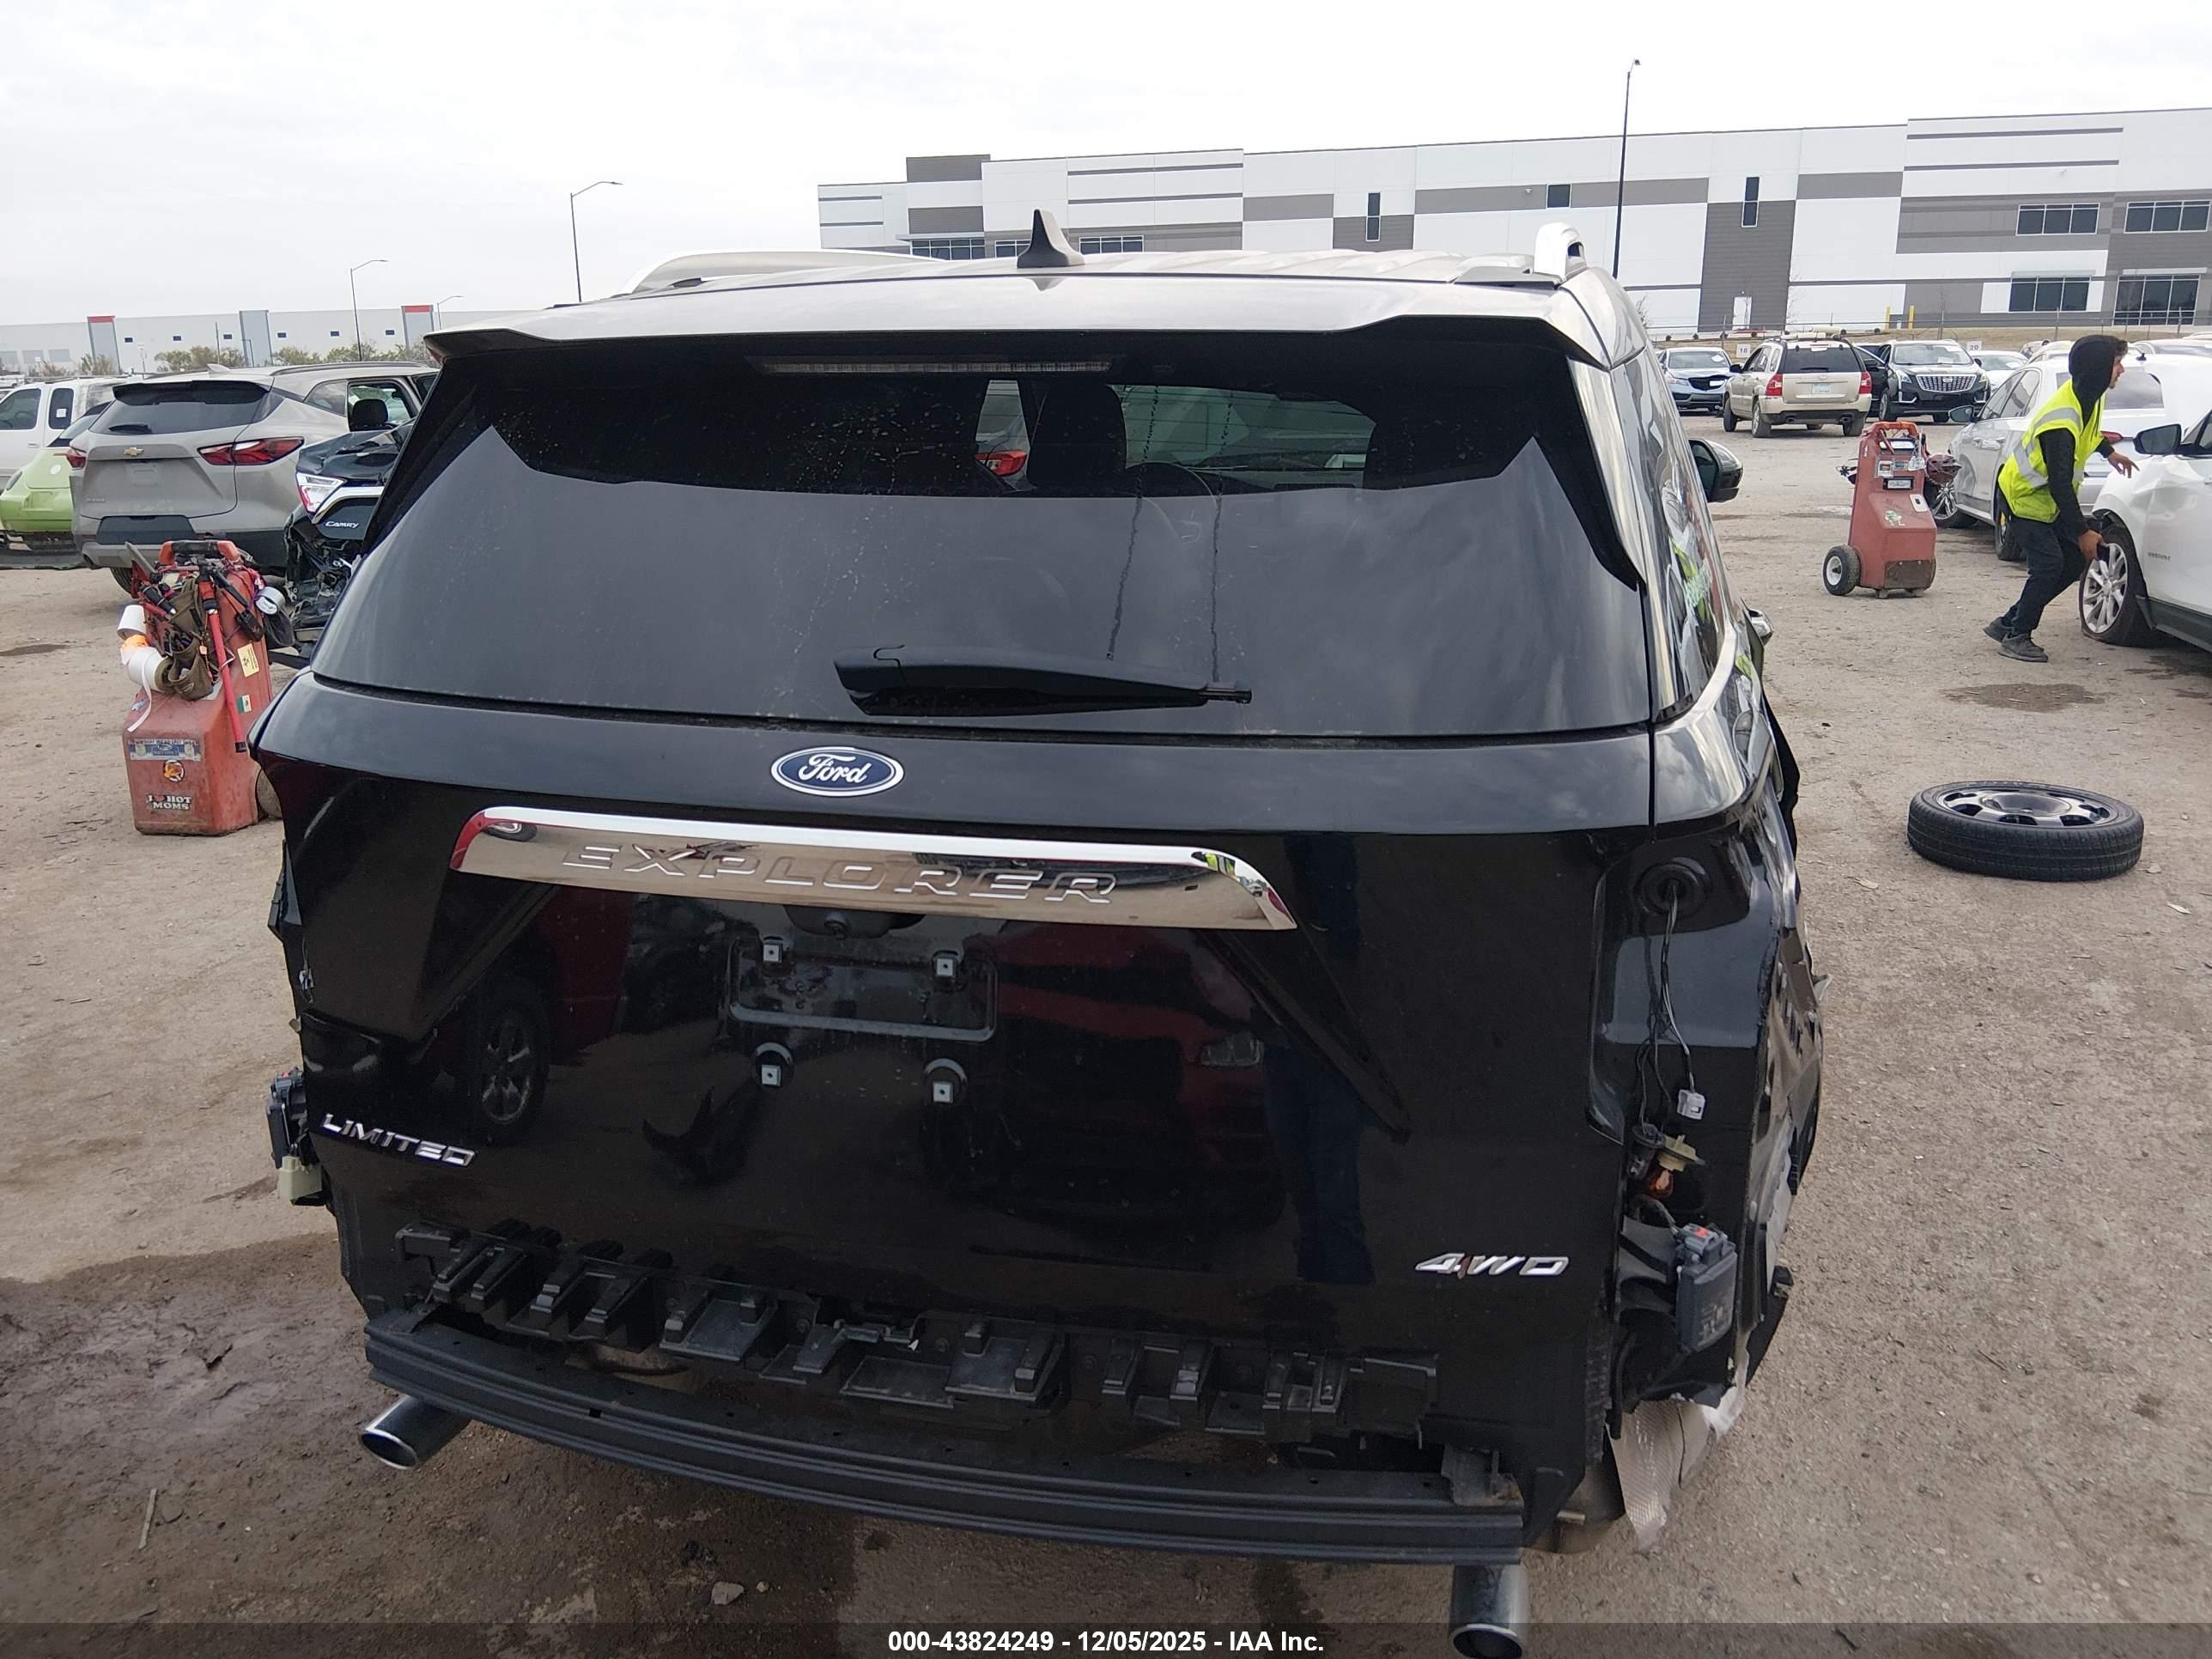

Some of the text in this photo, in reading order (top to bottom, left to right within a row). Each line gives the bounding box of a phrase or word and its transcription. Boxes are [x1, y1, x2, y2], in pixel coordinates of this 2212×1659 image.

[798, 753, 872, 784] Ford
[153, 802, 190, 811] MOMS
[167, 795, 192, 804] HOT
[562, 845, 1117, 904] EXPLORER
[322, 1113, 476, 1166] LIMITED
[1415, 1253, 1569, 1275] 4WD
